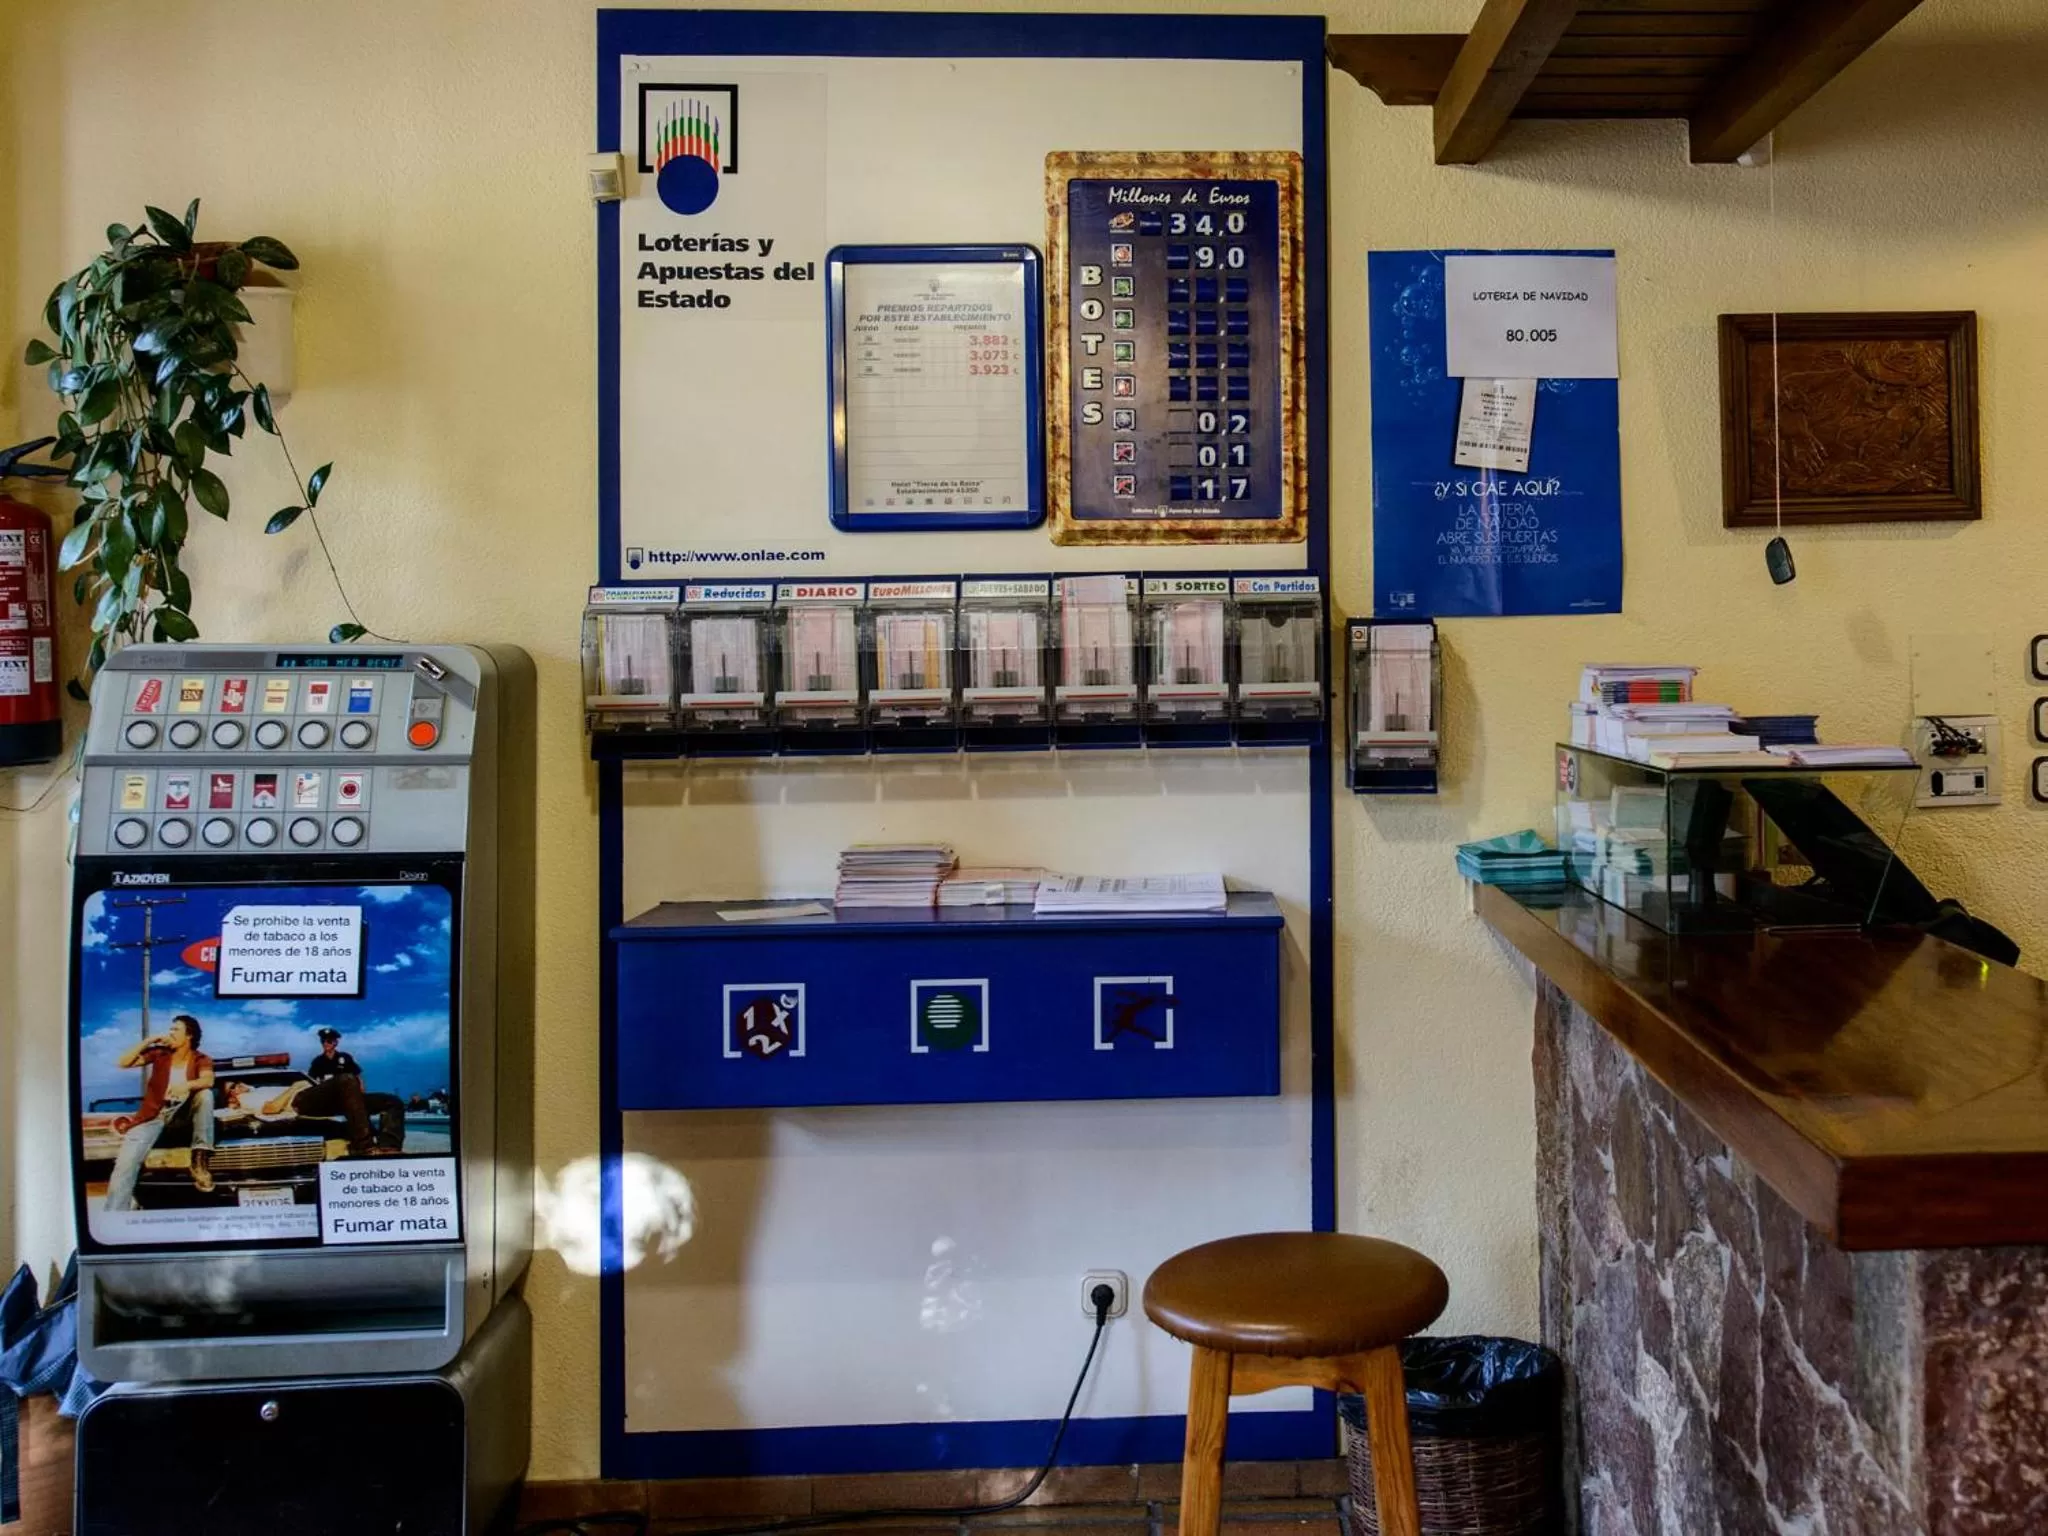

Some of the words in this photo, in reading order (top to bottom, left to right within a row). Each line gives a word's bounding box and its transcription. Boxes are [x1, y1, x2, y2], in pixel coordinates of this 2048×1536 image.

[1109, 186, 1171, 204] Millones
[1181, 188, 1198, 204] de
[1209, 186, 1250, 204] Euros
[637, 233, 750, 251] Loterías
[758, 238, 774, 257] y
[637, 262, 764, 284] Apuestas
[773, 262, 814, 280] del
[637, 289, 731, 308] Estado
[1472, 291, 1519, 301] LOTERIA
[1523, 291, 1536, 301] DE
[1540, 291, 1588, 301] NAVIDAD
[877, 304, 925, 313] PREMIOS
[927, 303, 993, 312] REPARTIDOS
[859, 314, 881, 323] POR
[884, 314, 912, 322] ESTE
[913, 313, 1011, 322] ESTABLECIMIENTO
[1506, 329, 1557, 342] 80.005
[1080, 265, 1104, 425] BOTES
[1471, 481, 1507, 497] CAE
[1436, 531, 1471, 544] ABRE
[1501, 530, 1558, 545] PUERTAS
[649, 549, 825, 565] http://www.onlae.com
[704, 587, 766, 598] Reducidas
[796, 586, 857, 597] DIARIO
[1175, 582, 1226, 591] SORTEO
[1273, 581, 1316, 591] Partidos
[233, 915, 249, 926] Se
[253, 915, 300, 929] prohibe
[302, 915, 314, 926] la
[317, 917, 350, 926] venta
[244, 931, 260, 941] de
[263, 931, 305, 941] tabaco
[320, 931, 338, 941] los
[228, 948, 281, 957] menores
[285, 947, 301, 957] de
[305, 947, 318, 957] 18
[322, 947, 351, 957] años
[231, 967, 293, 983] Fumar
[300, 968, 348, 983] mata
[330, 1170, 346, 1181] Se
[349, 1169, 395, 1181] prohibe
[398, 1168, 409, 1178] la
[412, 1168, 446, 1178] venta
[342, 1184, 358, 1194] de
[361, 1183, 403, 1194] tabaco
[406, 1184, 414, 1192] a
[417, 1182, 435, 1192] los
[328, 1199, 381, 1209] menores
[384, 1197, 400, 1207] de
[404, 1196, 417, 1207] 18
[420, 1196, 450, 1206] años
[333, 1218, 394, 1234] Fumar
[400, 1216, 449, 1231] mata
